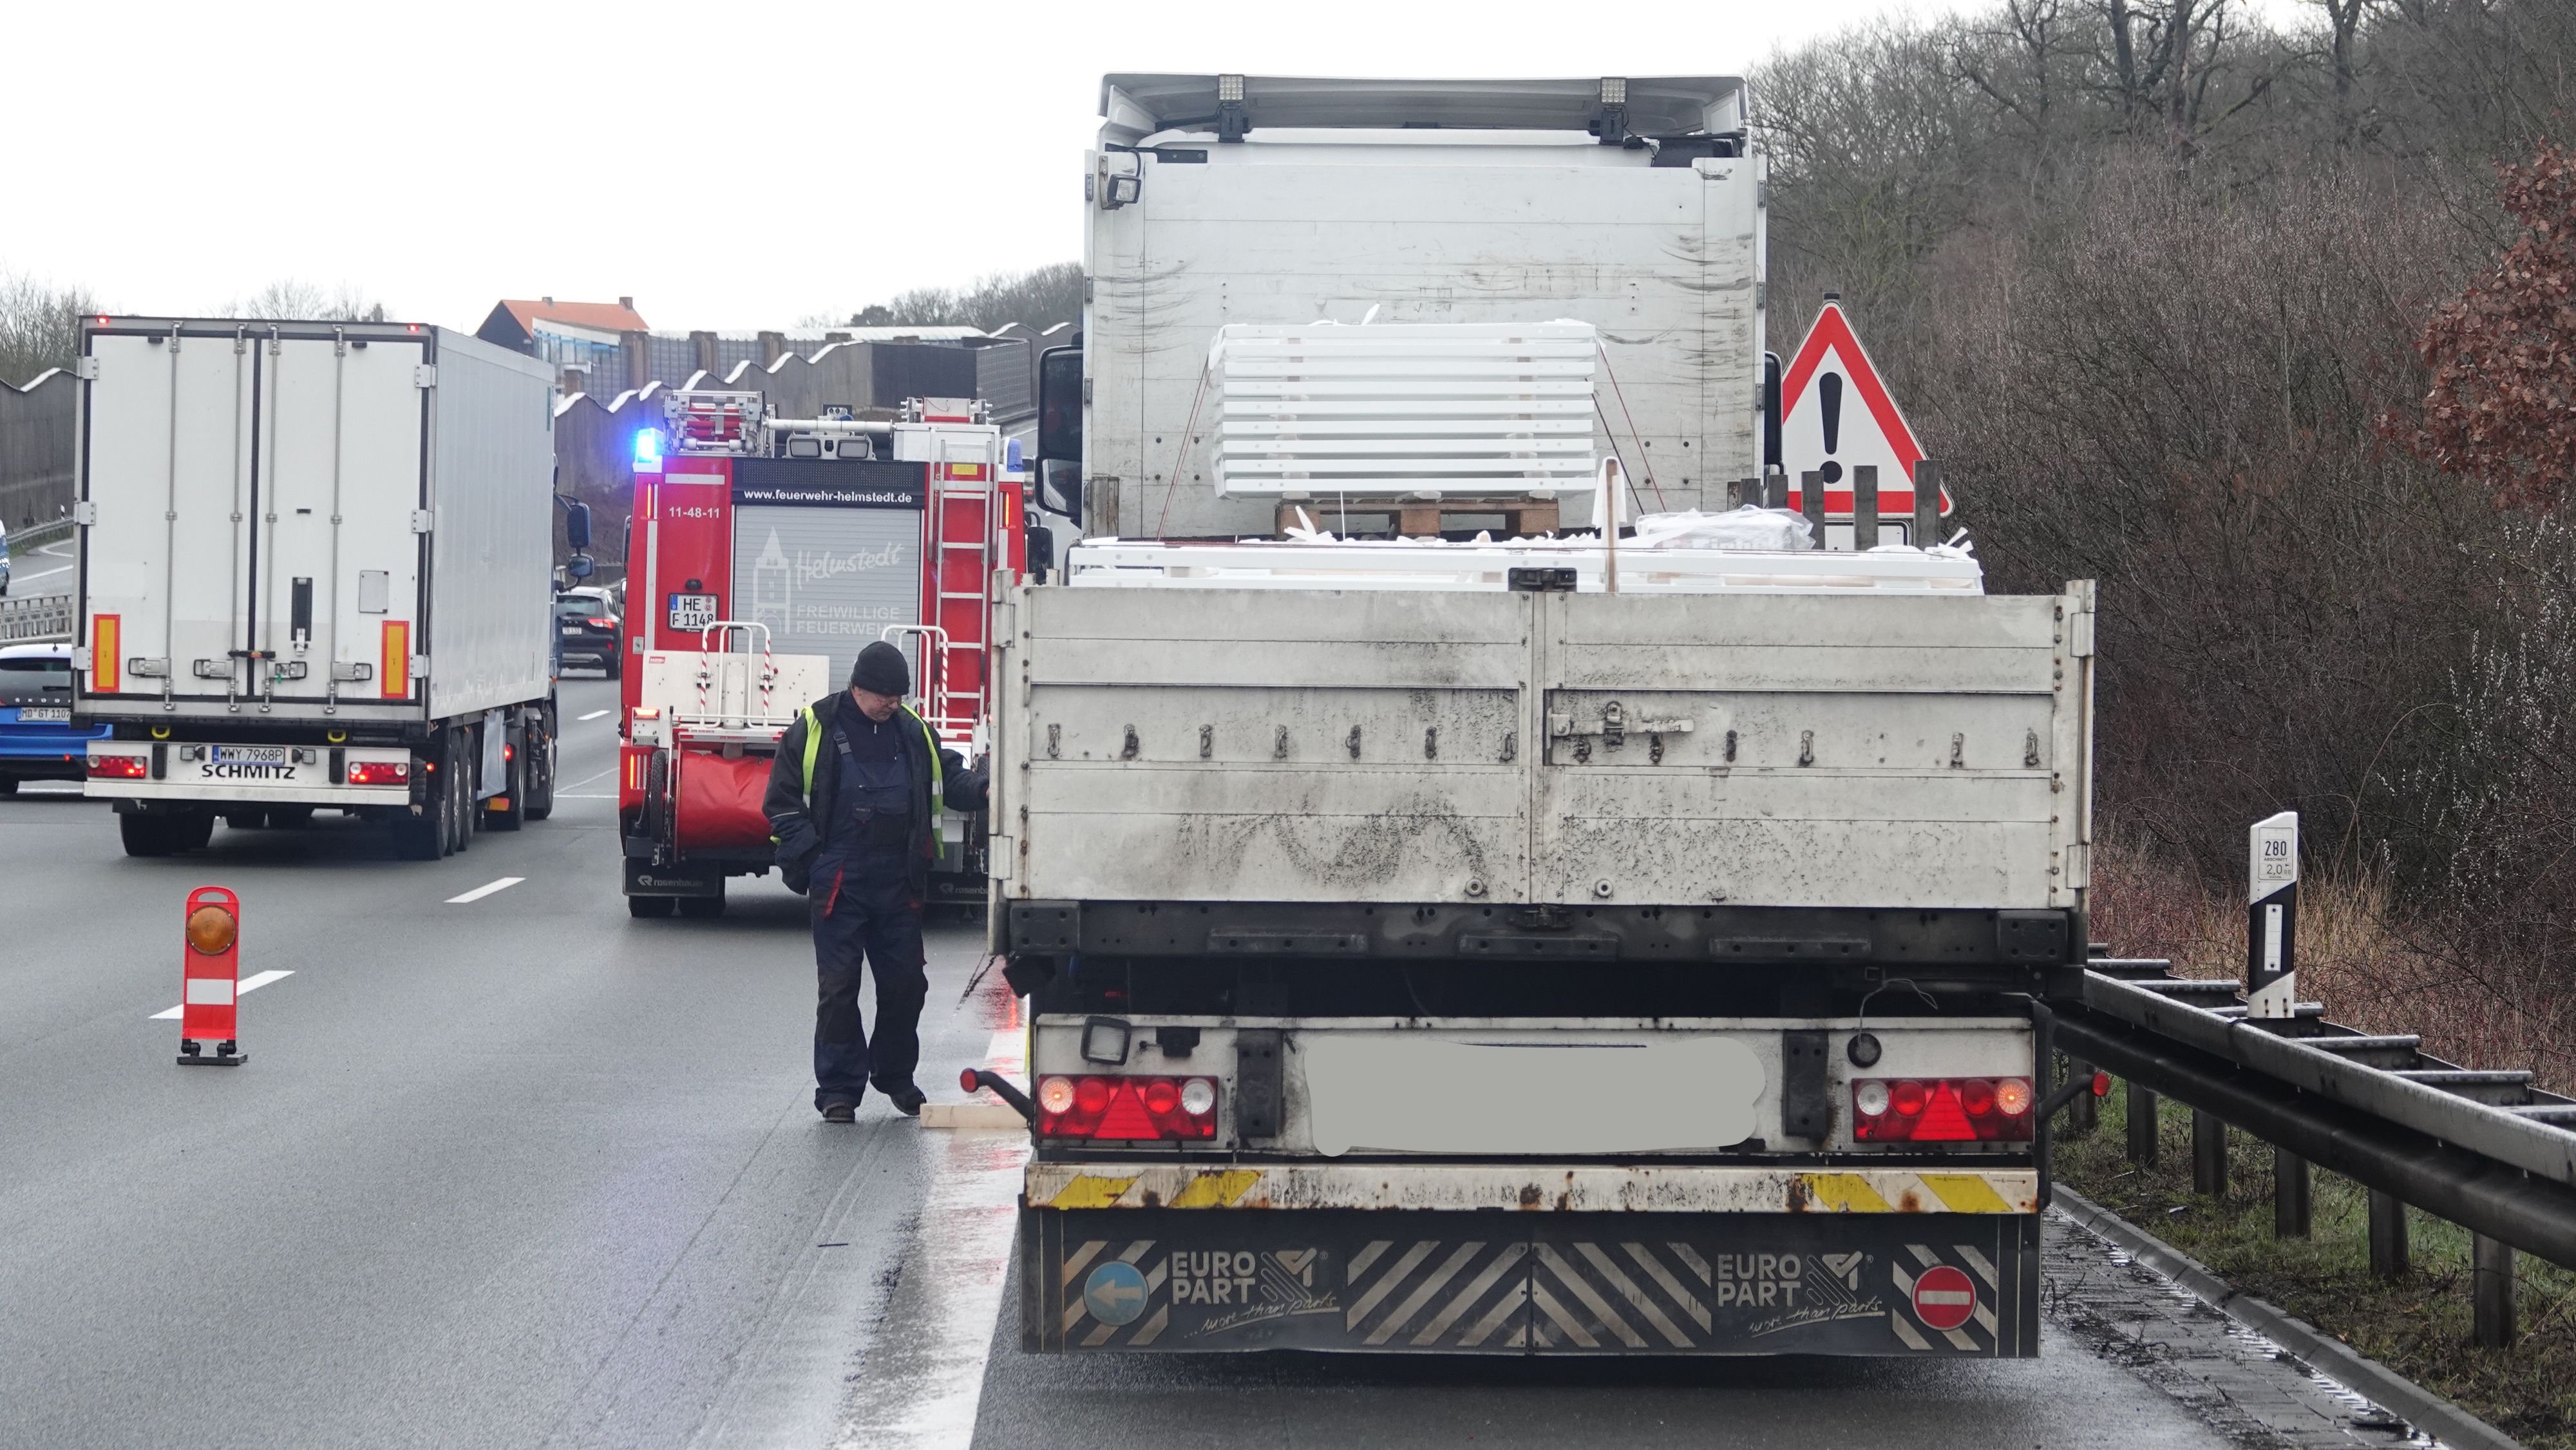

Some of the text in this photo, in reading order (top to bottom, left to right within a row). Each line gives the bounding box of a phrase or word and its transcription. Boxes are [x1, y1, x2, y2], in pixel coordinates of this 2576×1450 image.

[743, 489, 913, 504] www.feuerwehr-helmstedt.de
[668, 506, 720, 518] 11-48-11
[795, 541, 905, 591] Helmstedt
[683, 598, 701, 611] HE
[672, 613, 714, 627] F 1148
[797, 605, 900, 620] FREIWILLIGE
[22, 709, 71, 719] MD GT 1107
[220, 748, 283, 761] WWY 7968P
[202, 765, 296, 779] SCHMITZ
[2265, 841, 2287, 856] 280
[955, 886, 989, 894] rosenb
[1172, 1251, 1256, 1278] EURO
[1718, 1254, 1801, 1280] EURO
[1173, 1278, 1256, 1304] PART
[1718, 1281, 1801, 1308] PART
[1241, 1302, 1285, 1319] than
[1285, 1291, 1337, 1317] parts
[1786, 1306, 1830, 1321] than
[1831, 1295, 1883, 1321] parts
